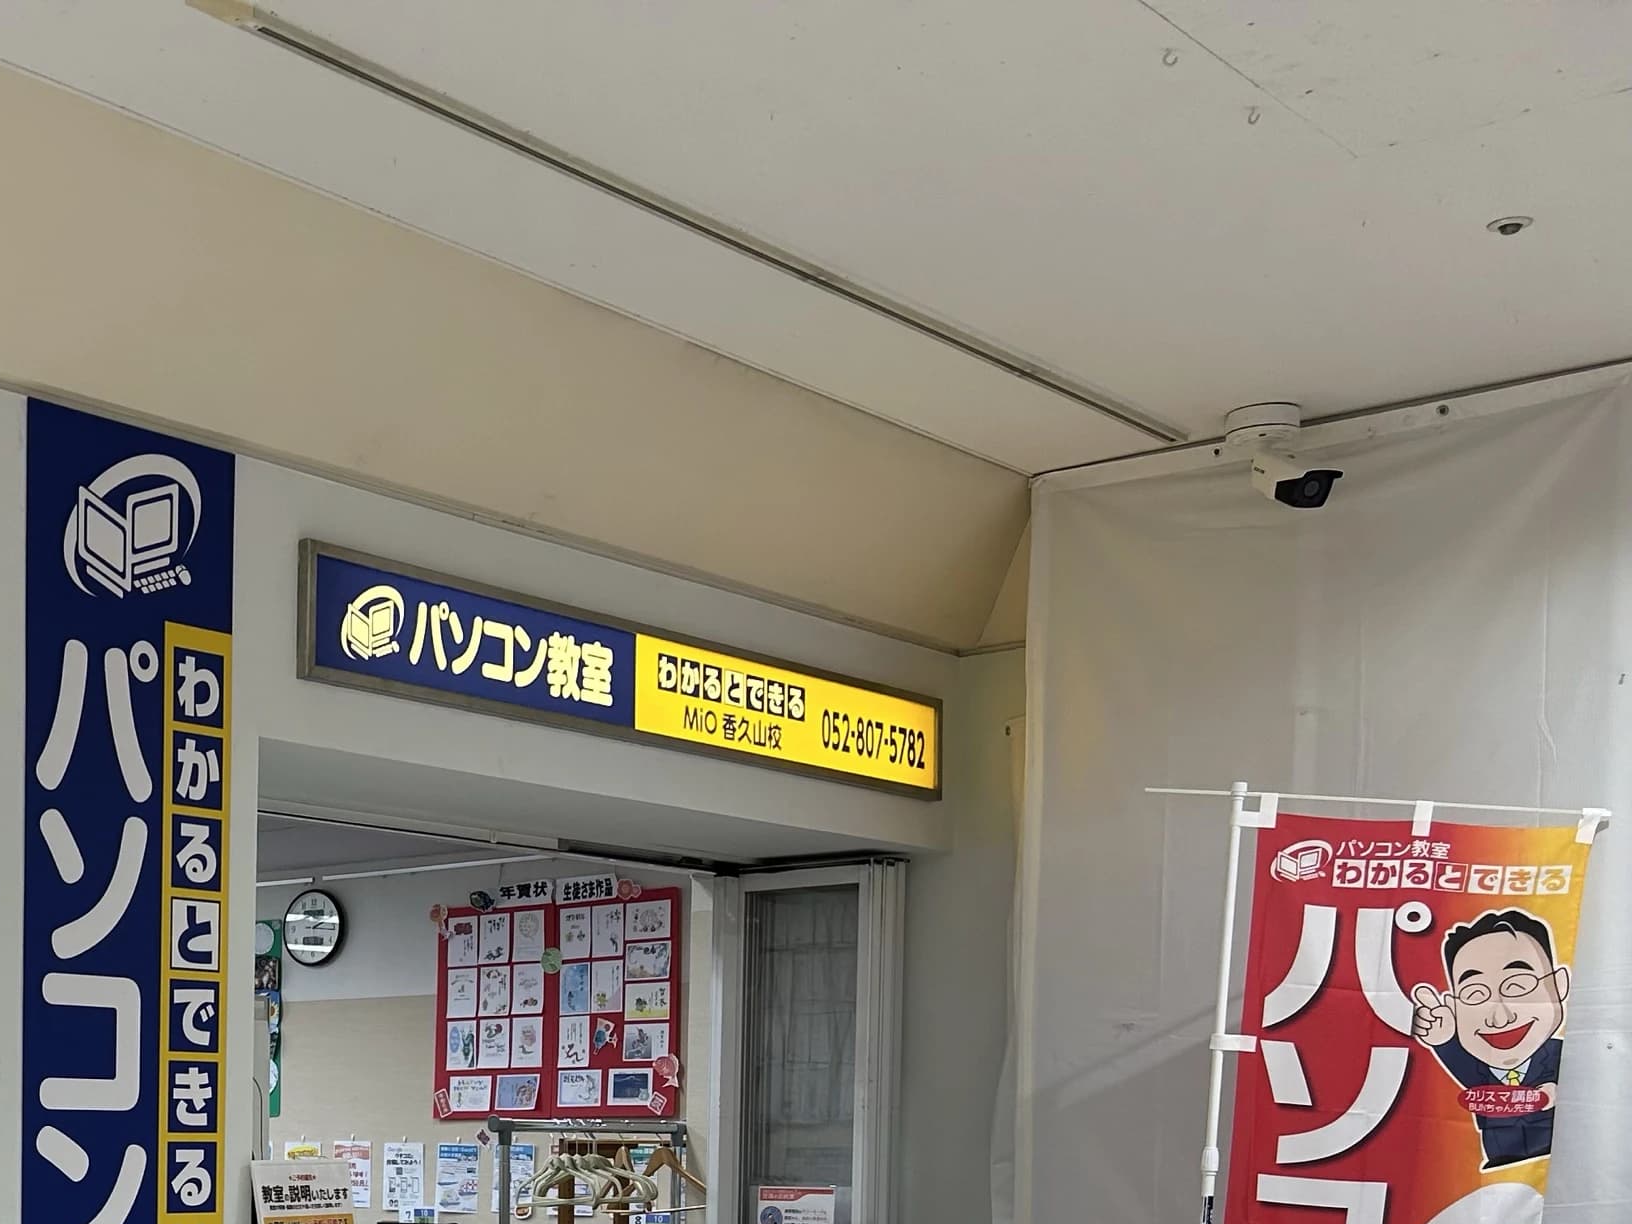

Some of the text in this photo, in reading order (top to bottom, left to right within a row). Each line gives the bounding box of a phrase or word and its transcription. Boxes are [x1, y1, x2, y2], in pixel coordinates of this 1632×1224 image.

[409, 601, 613, 706] パソコン教室
[657, 653, 805, 722] わかるとできる
[821, 708, 925, 769] 052-807-5782
[1336, 839, 1451, 860] パソコン教室
[499, 877, 614, 902] 年賀状 生徒さま作品
[1335, 860, 1570, 895] わかるとできる
[171, 654, 223, 1208] わかるとできる
[1464, 1089, 1541, 1105] カリスマ講師
[262, 1184, 349, 1204] 教室の説明いたします
